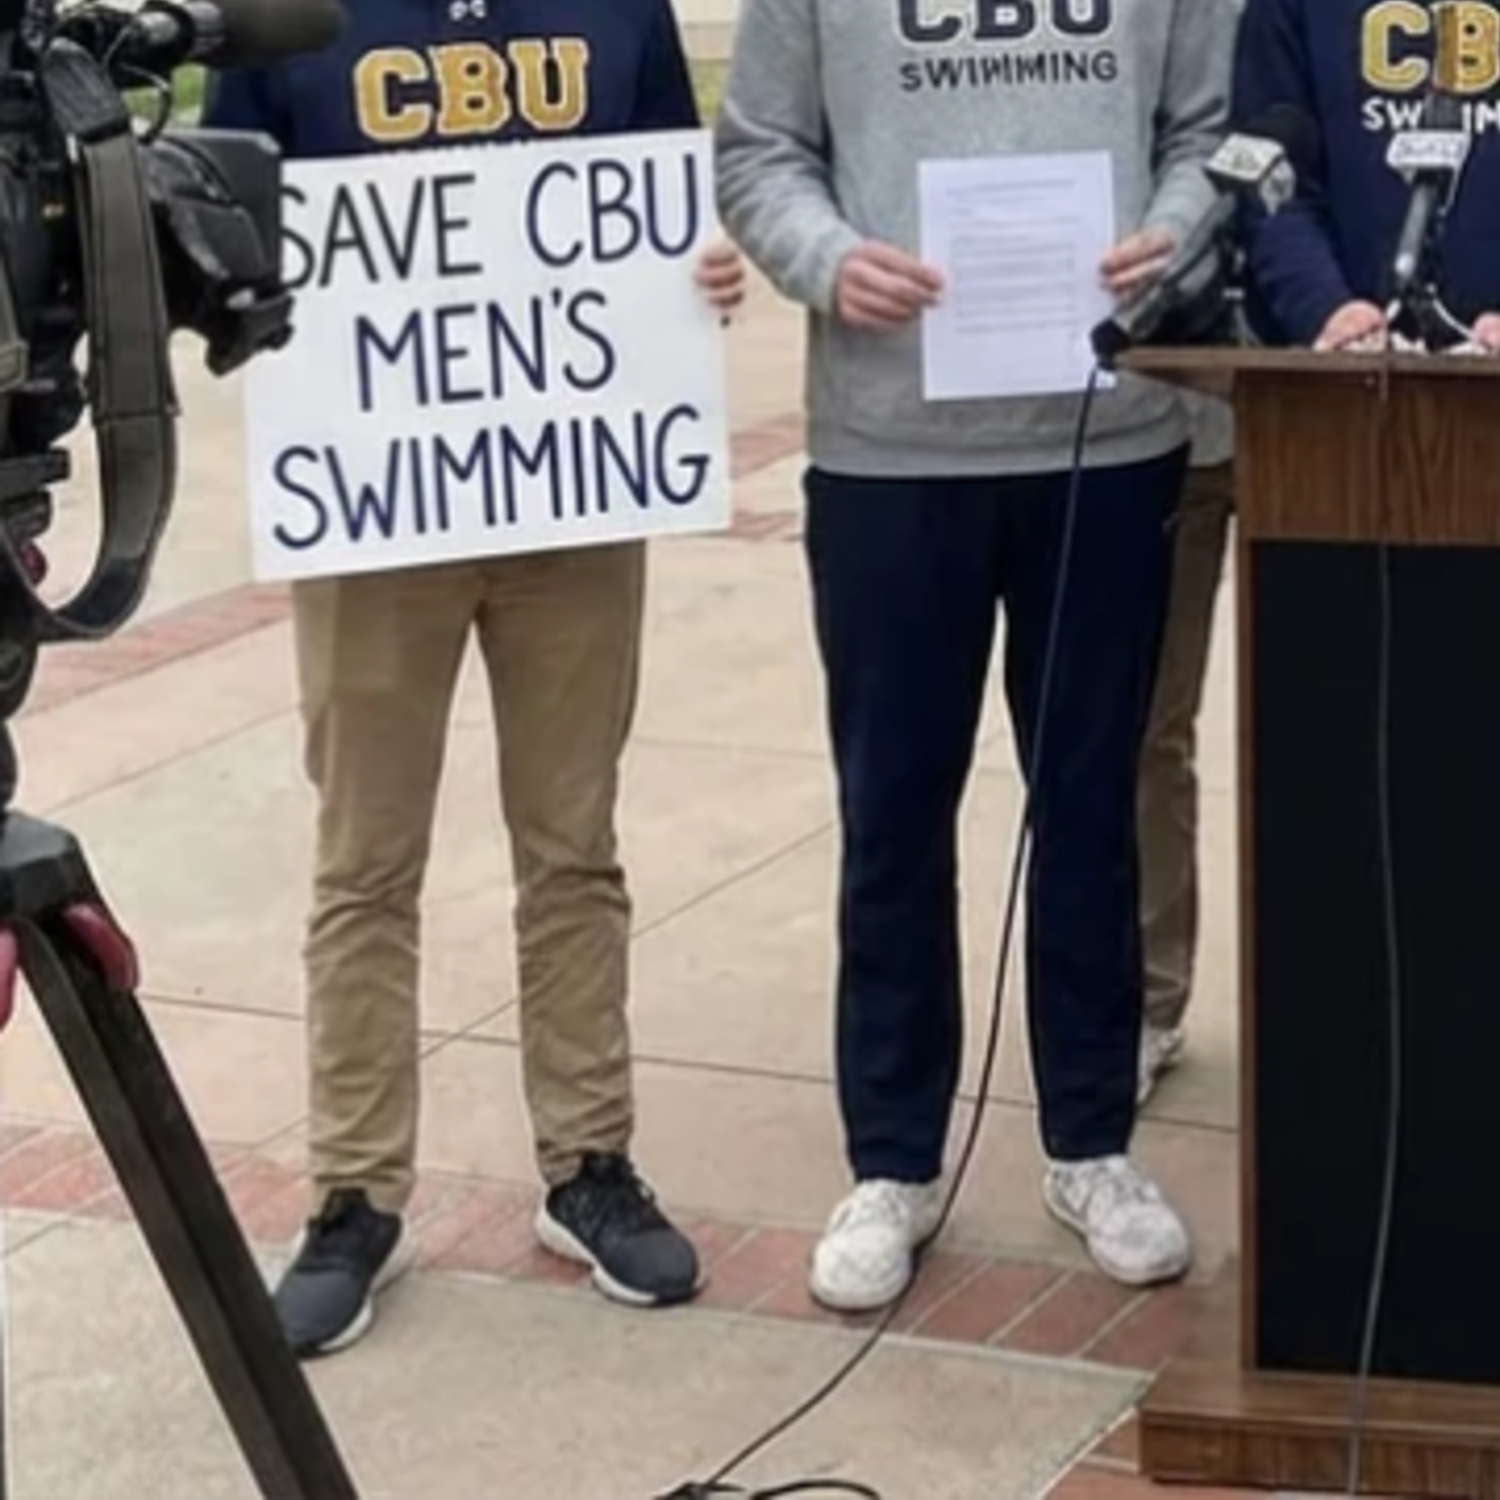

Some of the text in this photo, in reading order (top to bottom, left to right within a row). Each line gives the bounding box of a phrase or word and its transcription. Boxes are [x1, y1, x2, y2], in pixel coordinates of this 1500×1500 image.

[354, 37, 589, 141] CBU
[526, 153, 699, 268] CBU
[355, 287, 616, 412] MEN'S
[273, 403, 711, 550] SWIMMING
